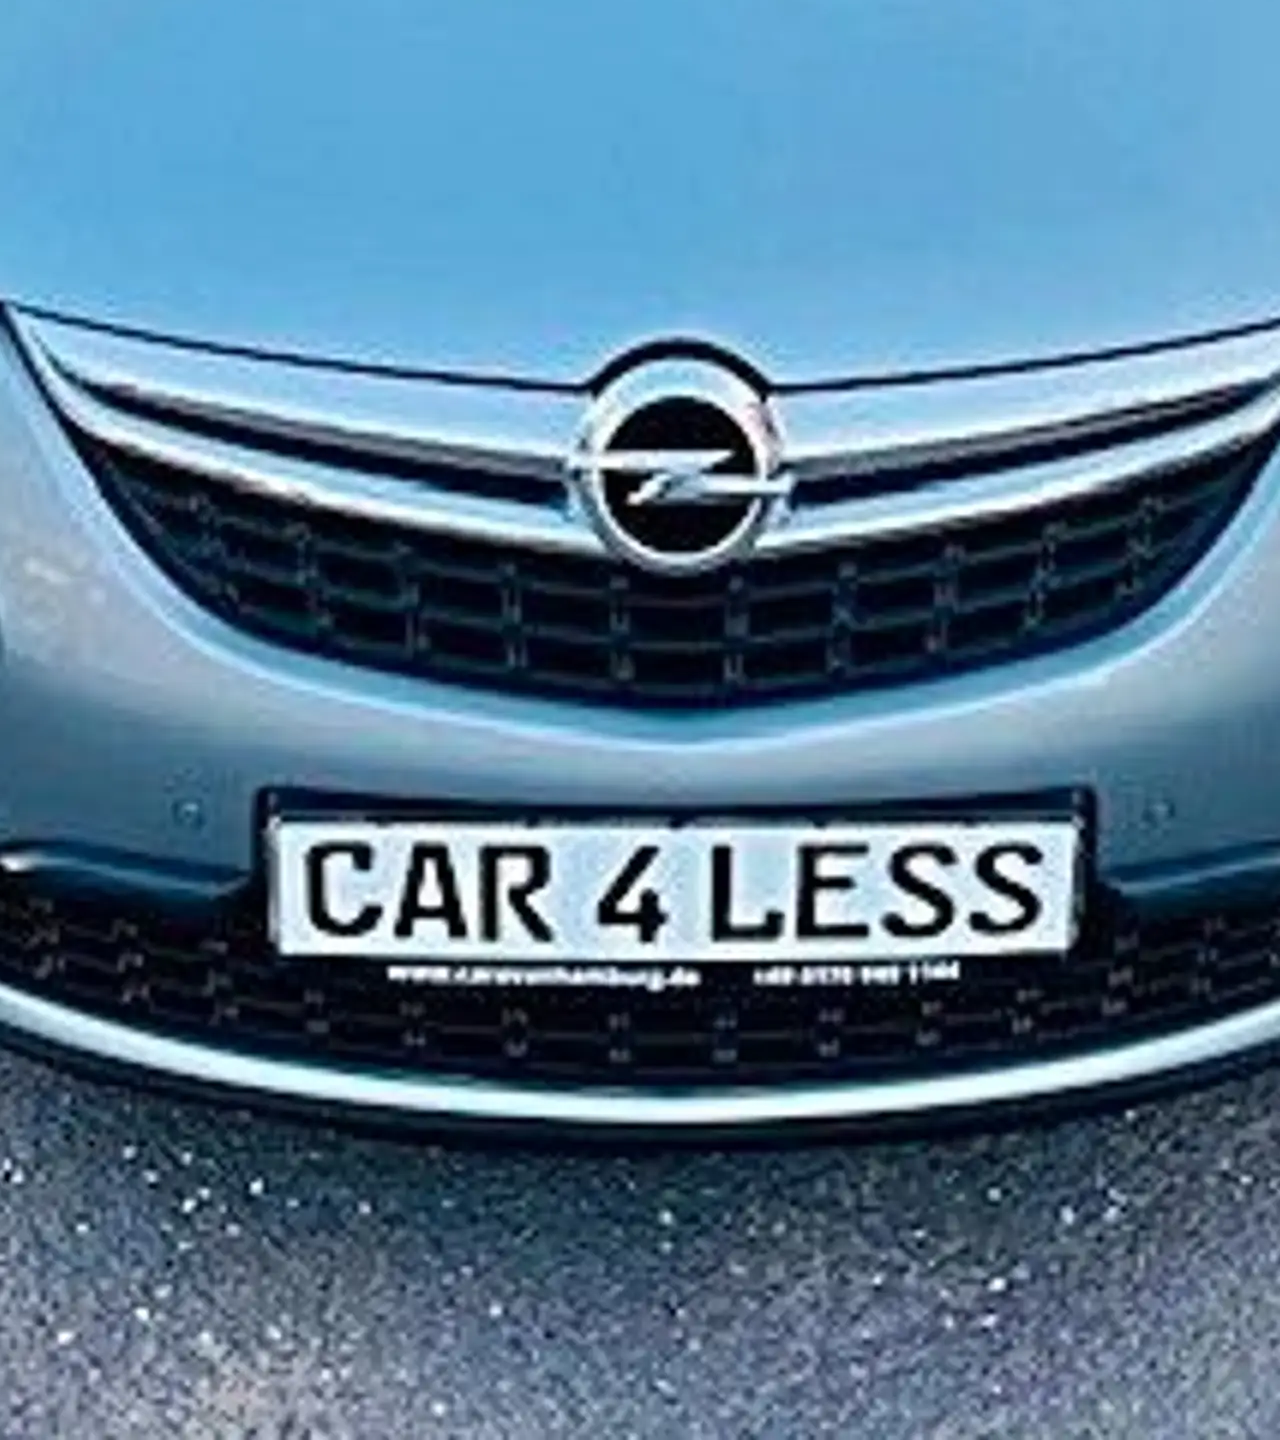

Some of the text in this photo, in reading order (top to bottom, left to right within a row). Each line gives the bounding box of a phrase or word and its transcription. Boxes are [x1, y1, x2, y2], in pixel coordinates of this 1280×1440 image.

[304, 840, 1045, 943] CAR 4 LESS
